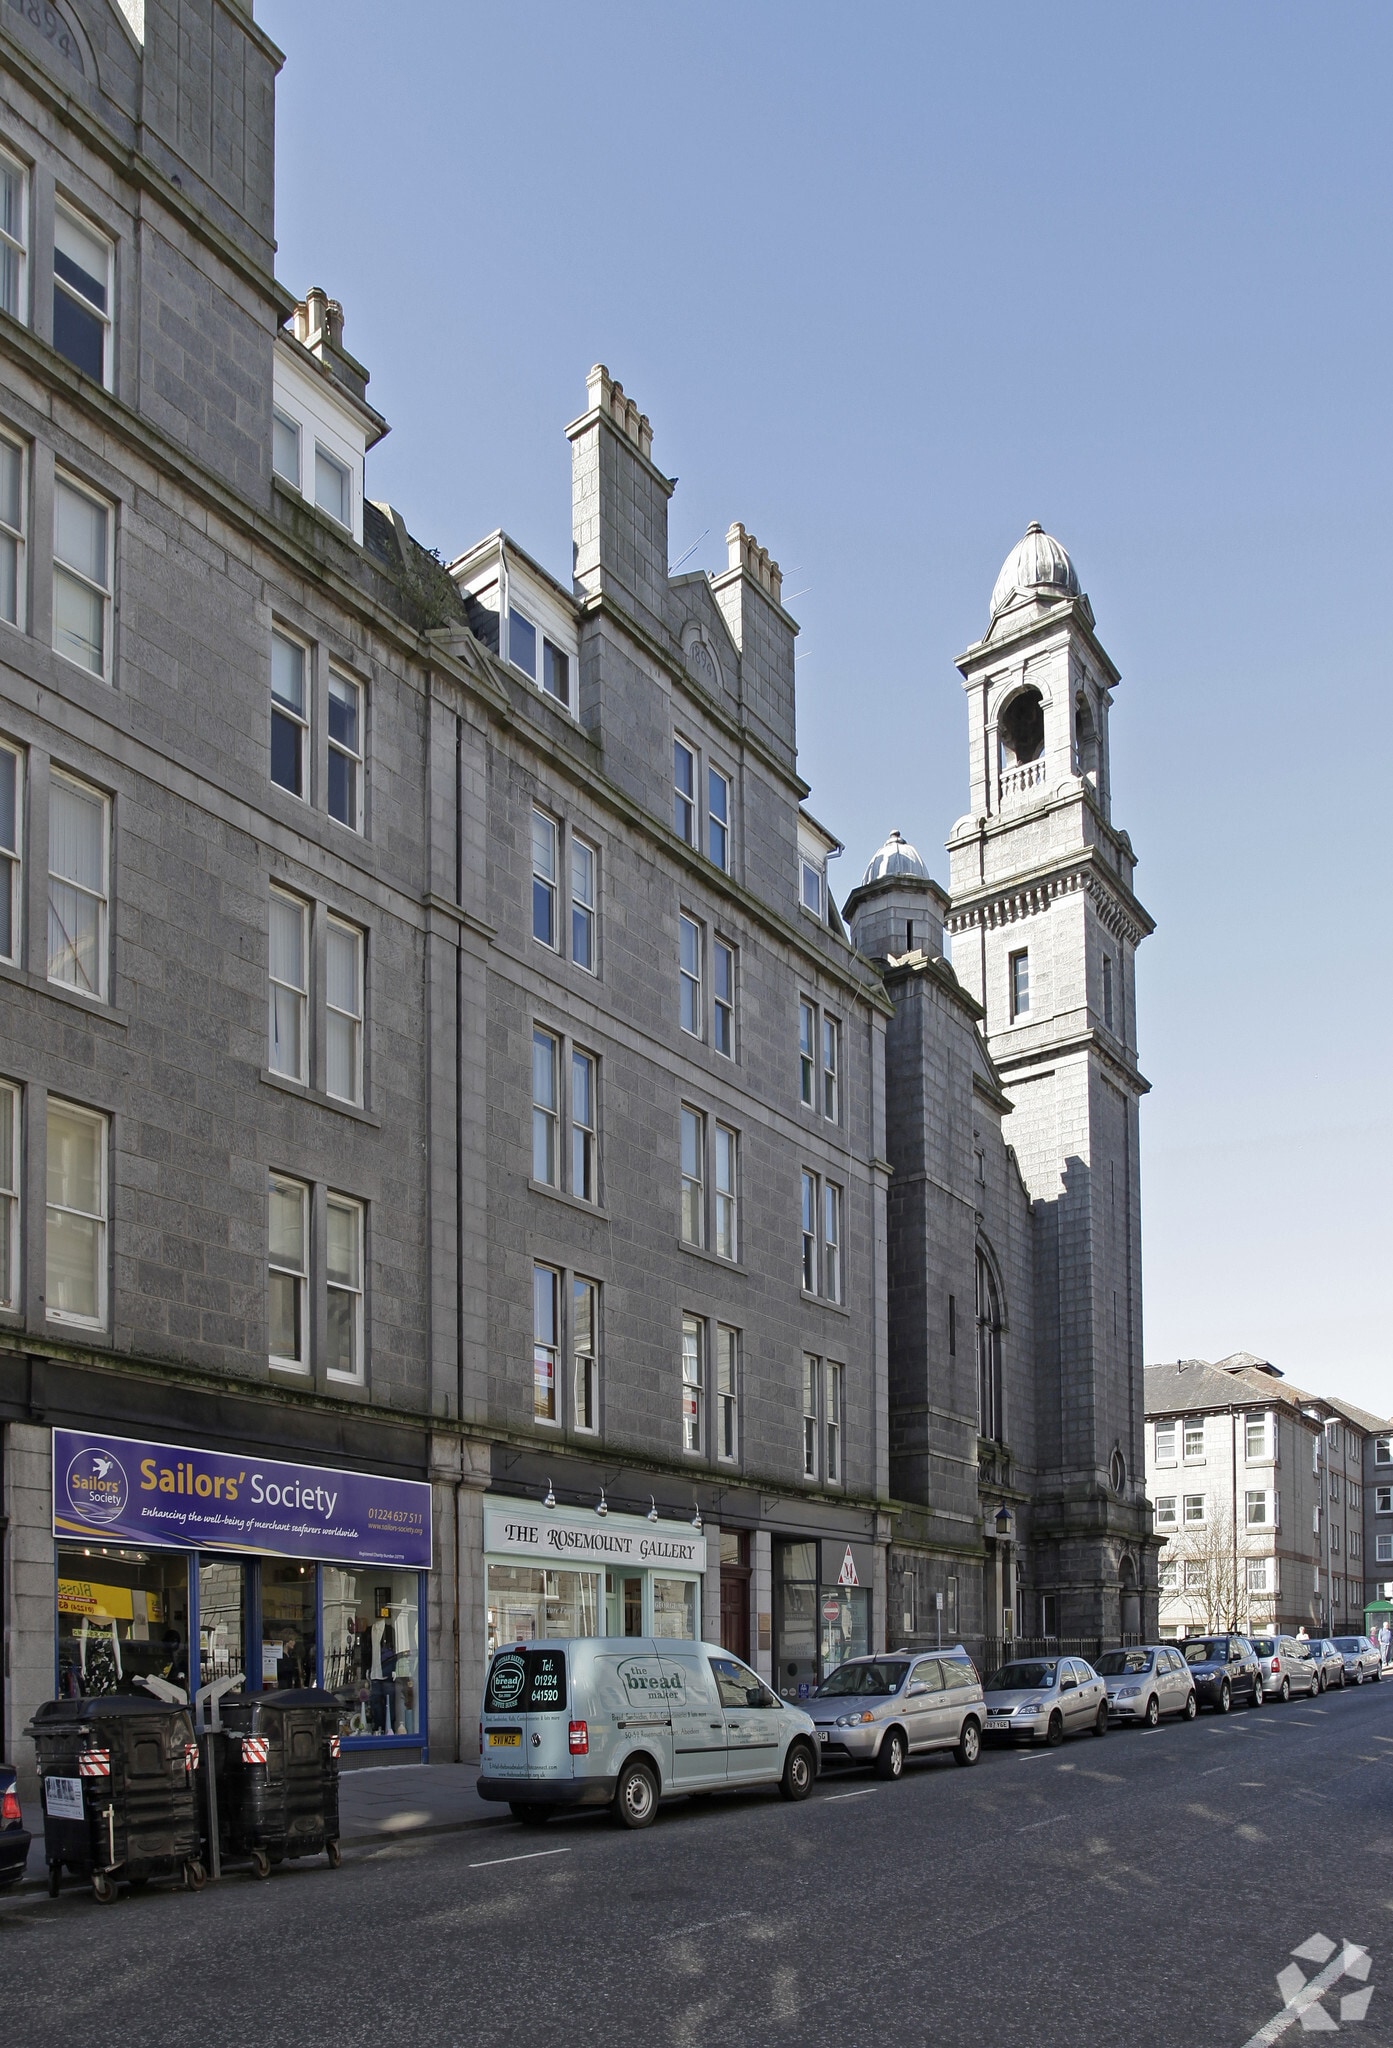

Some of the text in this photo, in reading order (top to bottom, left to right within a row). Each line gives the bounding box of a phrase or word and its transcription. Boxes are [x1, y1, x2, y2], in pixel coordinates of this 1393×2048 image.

[72, 1474, 121, 1493] Sailors'
[141, 1459, 338, 1520] Sailors' Society
[89, 1491, 121, 1506] Society
[141, 1507, 359, 1538] Enhancing the well-being of merchant seafarers worldwide
[368, 1508, 423, 1524] 01224 637 511
[368, 1523, 423, 1536] www.sailors-society.org
[505, 1524, 695, 1559] THE ROSEMOUNT GALLERY
[542, 1659, 554, 1671] Tel:
[630, 1667, 648, 1675] the
[495, 1677, 518, 1685] bread
[534, 1675, 558, 1686] 01224
[625, 1673, 683, 1690] bread
[531, 1690, 559, 1701] 641520
[648, 1691, 679, 1700] maker
